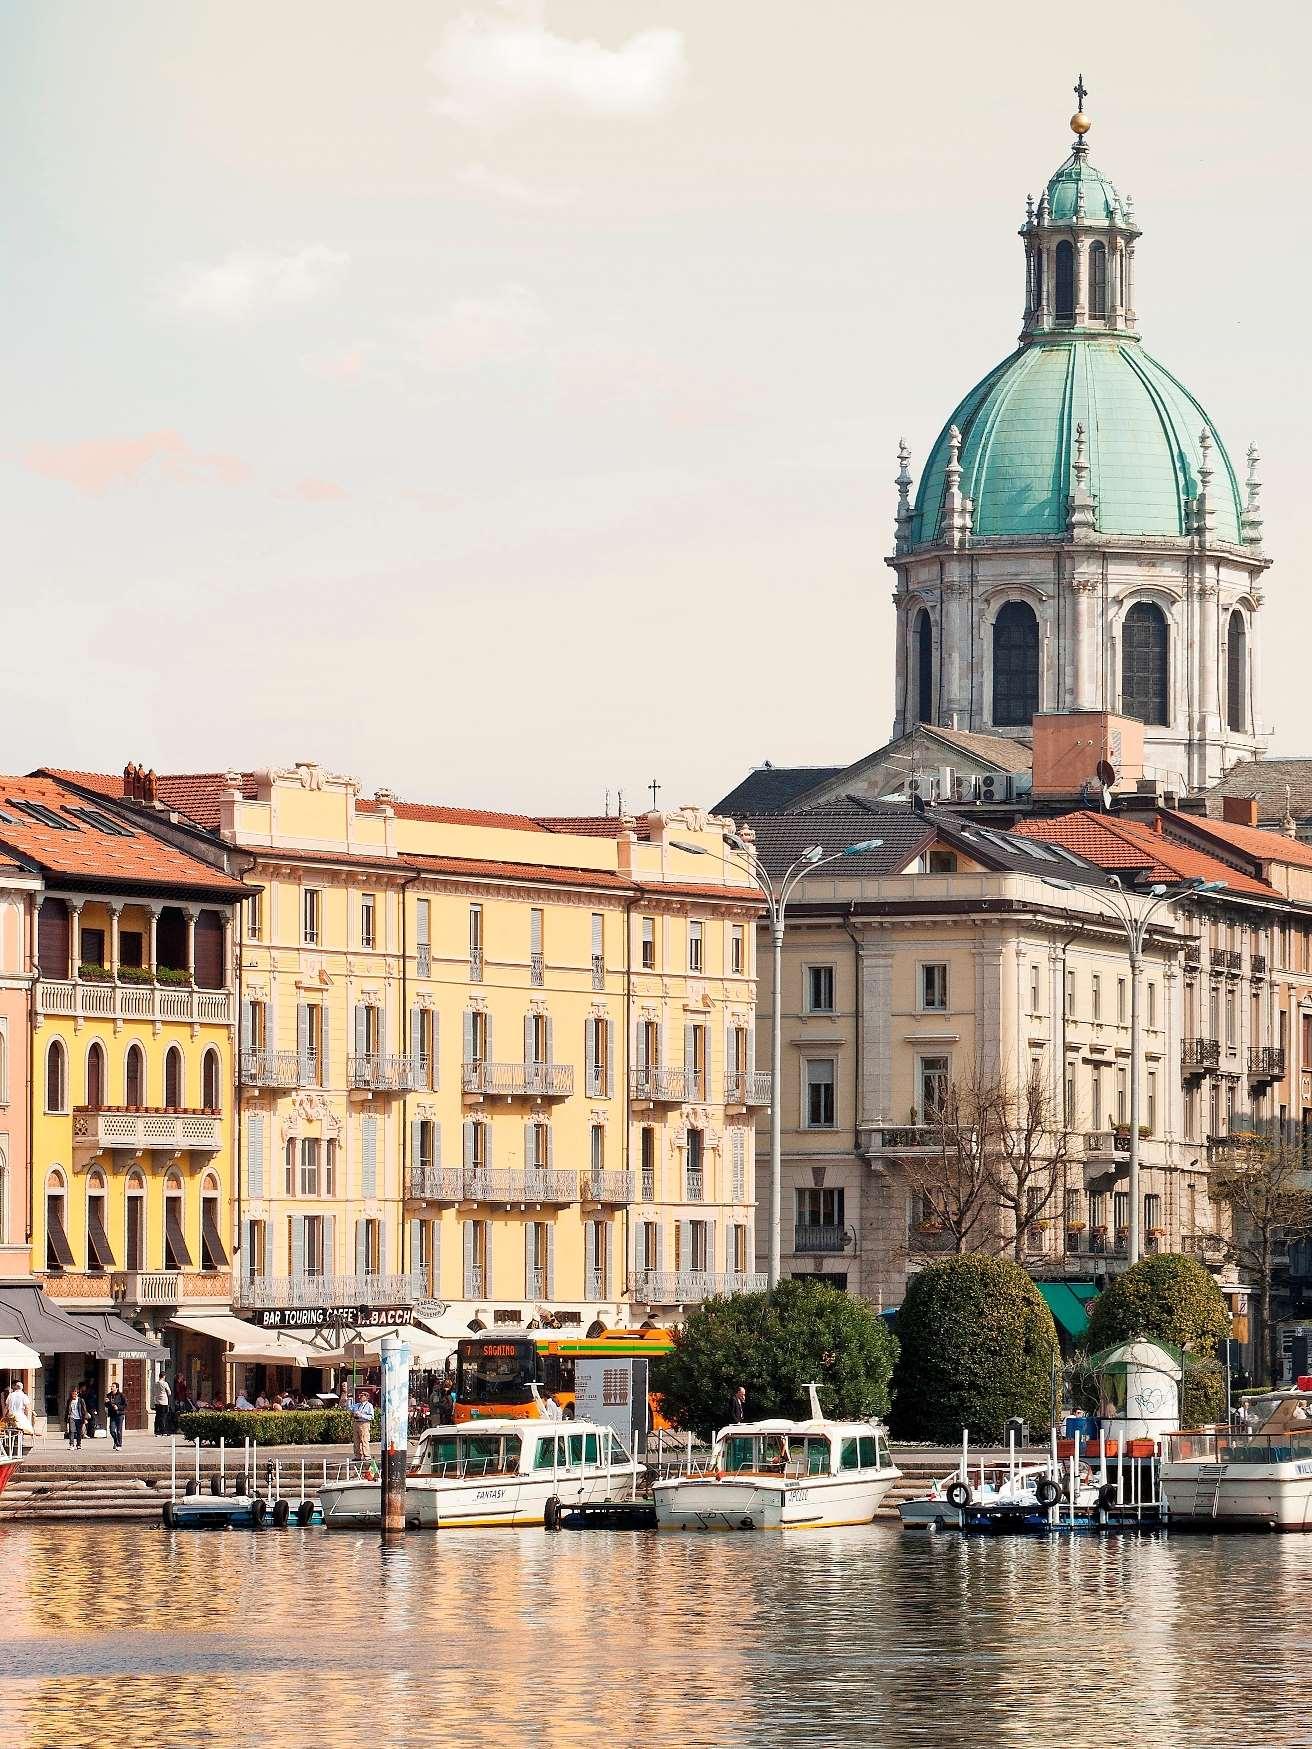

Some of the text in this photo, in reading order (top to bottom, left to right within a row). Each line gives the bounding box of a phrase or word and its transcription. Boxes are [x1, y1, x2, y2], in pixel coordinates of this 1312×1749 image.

[263, 1311, 281, 1325] BAR
[285, 1309, 324, 1325] TOURING
[465, 1345, 472, 1356] 7
[476, 1489, 506, 1500] FANTASY
